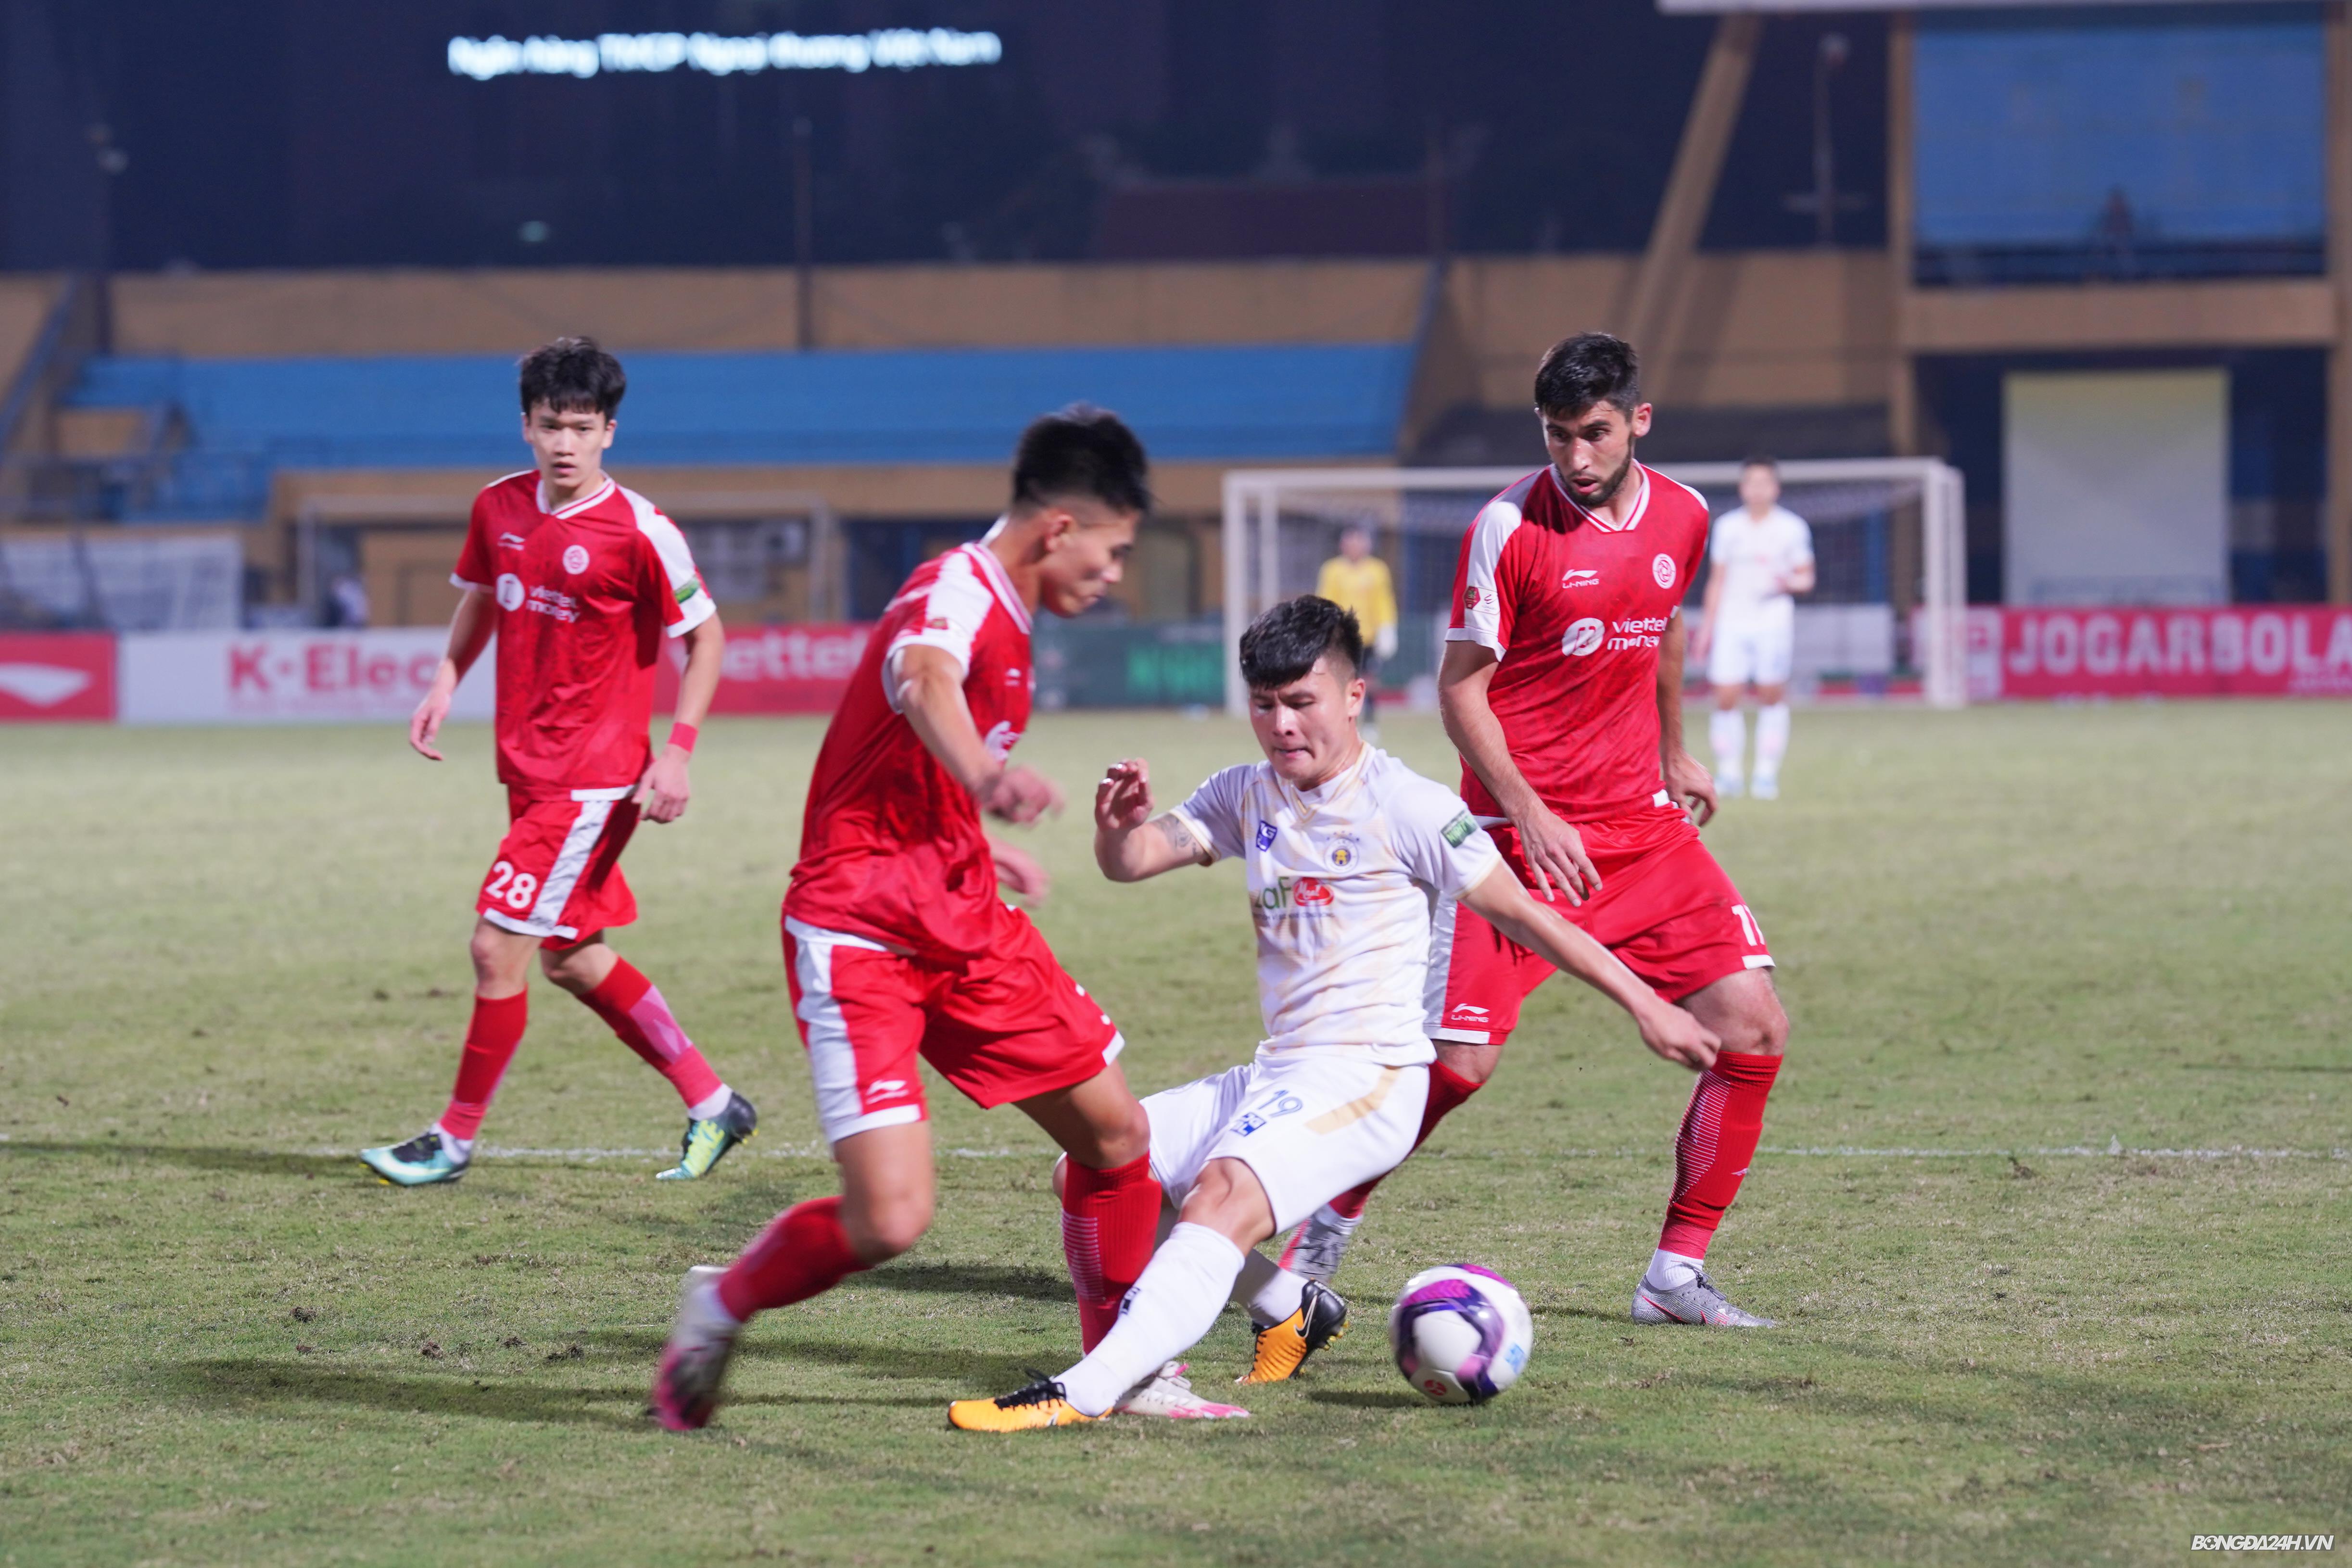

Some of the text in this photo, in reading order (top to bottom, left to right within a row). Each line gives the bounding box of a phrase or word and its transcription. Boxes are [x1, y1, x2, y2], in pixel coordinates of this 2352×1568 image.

[1612, 616, 1668, 633] viettel
[485, 860, 537, 909] 28
[1257, 1089, 1303, 1119] 19
